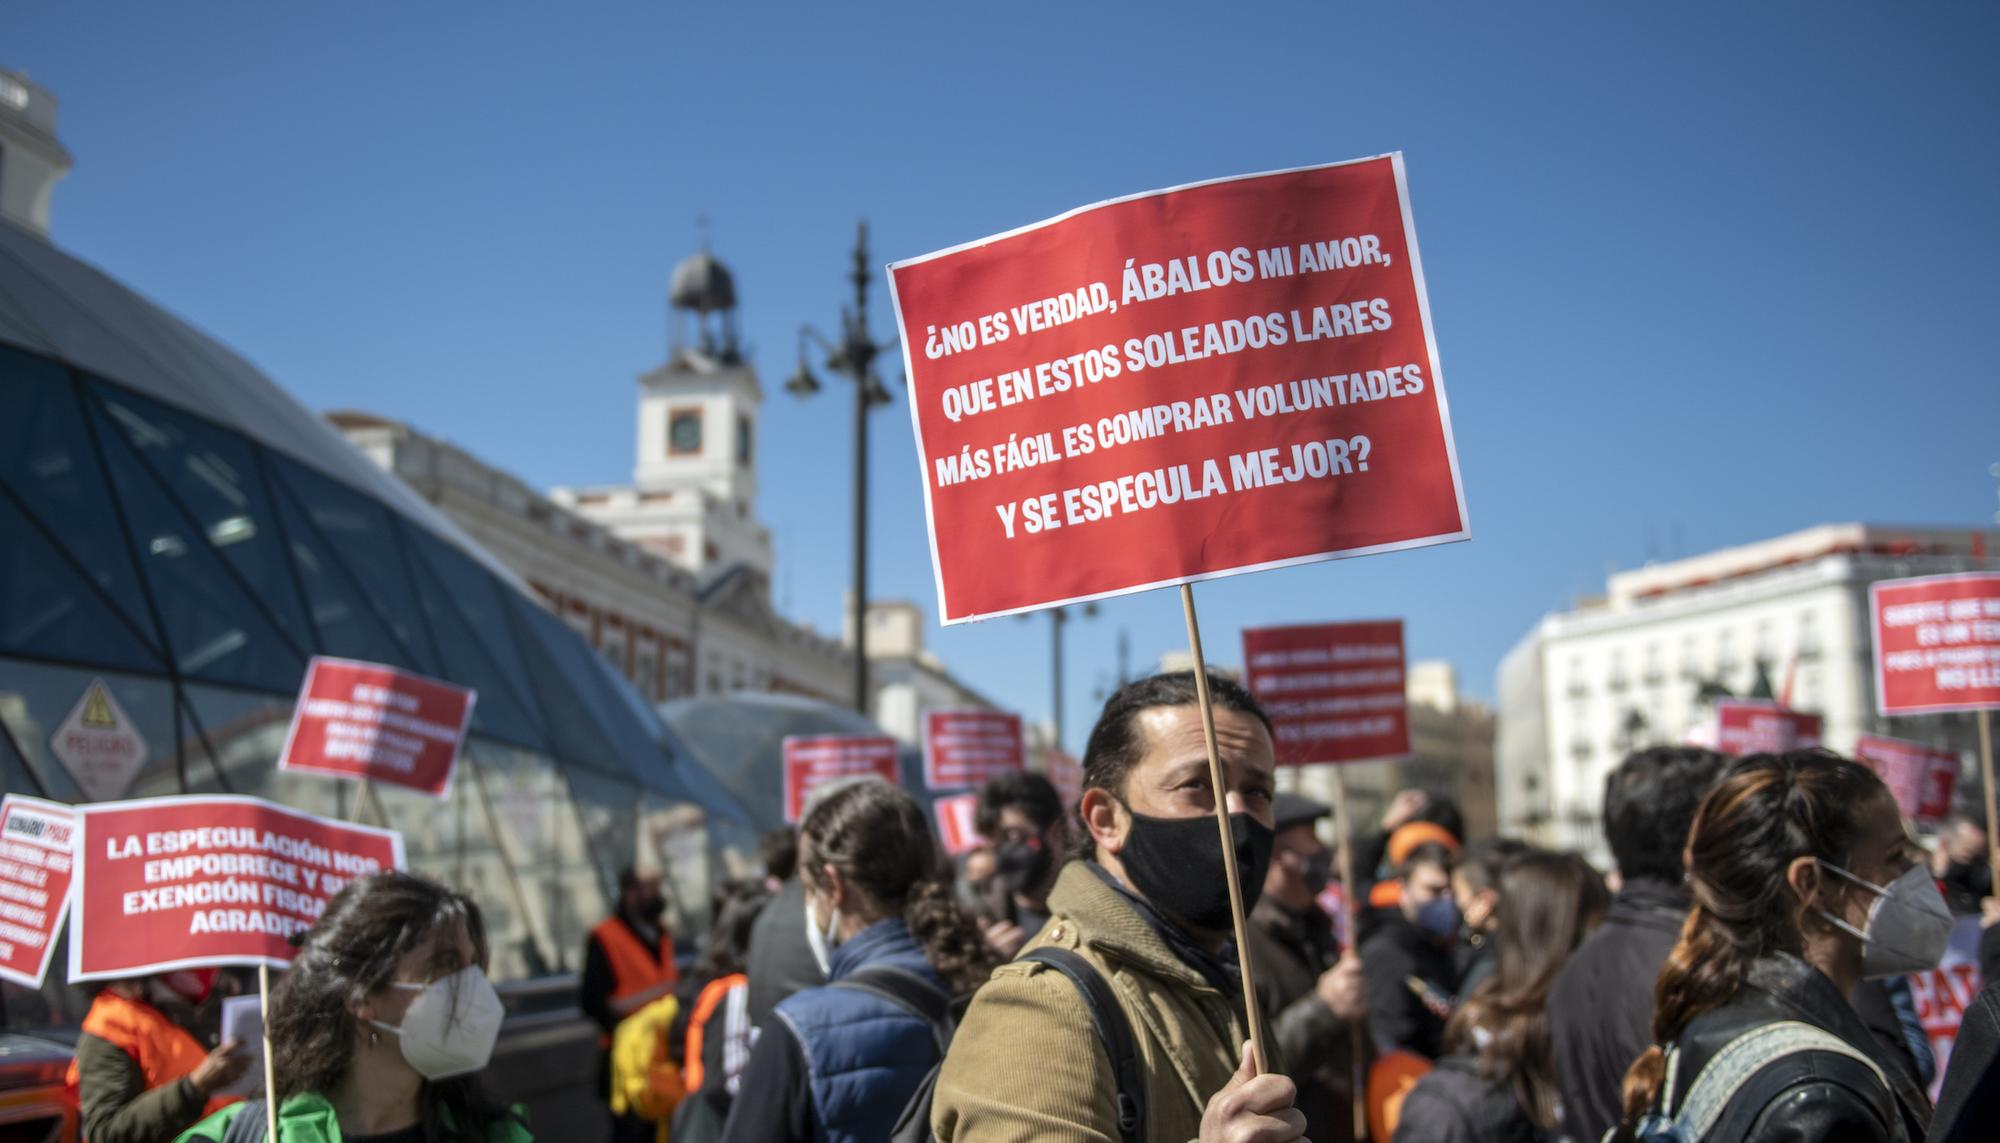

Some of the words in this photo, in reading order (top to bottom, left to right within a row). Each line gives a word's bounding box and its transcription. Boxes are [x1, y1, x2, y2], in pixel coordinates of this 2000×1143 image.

[925, 321, 977, 359] ¿NO
[979, 312, 1010, 345] ES
[1011, 282, 1117, 335] VERDAD,
[1122, 247, 1255, 305] ÁBALOS
[1257, 246, 1294, 279] MI
[1299, 235, 1391, 273] AMOR,
[942, 378, 996, 422] QUE
[998, 368, 1034, 406] EN
[1036, 344, 1121, 396] ESTOS
[1124, 312, 1288, 372] SOLEADOS
[1291, 298, 1392, 342] LARES
[936, 445, 991, 487] MÁS
[993, 432, 1061, 474] FÁCIL
[1063, 424, 1095, 458] ES
[1097, 394, 1233, 448] COMPRAR
[1235, 364, 1424, 419] VOLUNTADES
[996, 502, 1016, 538] Y
[1022, 493, 1061, 533] SE
[1063, 459, 1227, 525] ESPECULA
[1229, 435, 1371, 491] MEJOR?
[107, 834, 143, 860] LA
[147, 827, 331, 867] ESPECULACIÓN
[123, 876, 259, 916] EXENCIÓN
[144, 853, 299, 883] EMPOBRECE
[301, 868, 319, 890] Y
